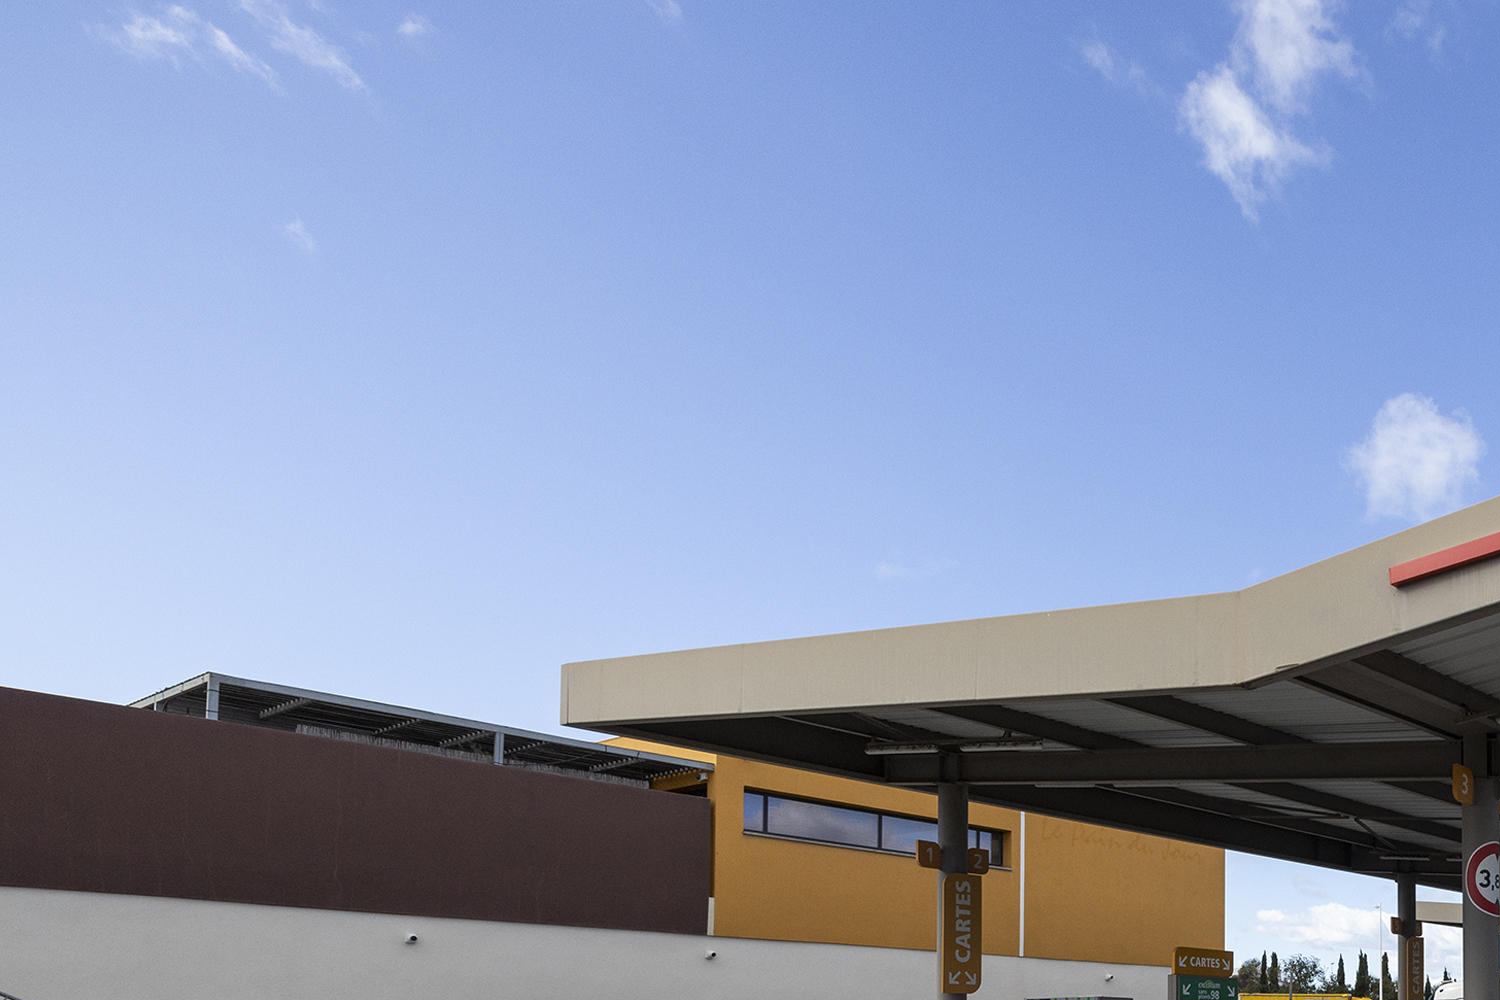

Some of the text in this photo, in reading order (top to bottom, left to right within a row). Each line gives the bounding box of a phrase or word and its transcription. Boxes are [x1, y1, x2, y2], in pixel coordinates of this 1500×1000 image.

[1461, 773, 1469, 795] 3
[926, 846, 933, 862] 1
[974, 854, 983, 869] 2
[955, 880, 971, 963] CARTES
[1189, 956, 1221, 969] CARTES
[1412, 941, 1420, 995] CARTES
[1210, 991, 1220, 1000] 98
